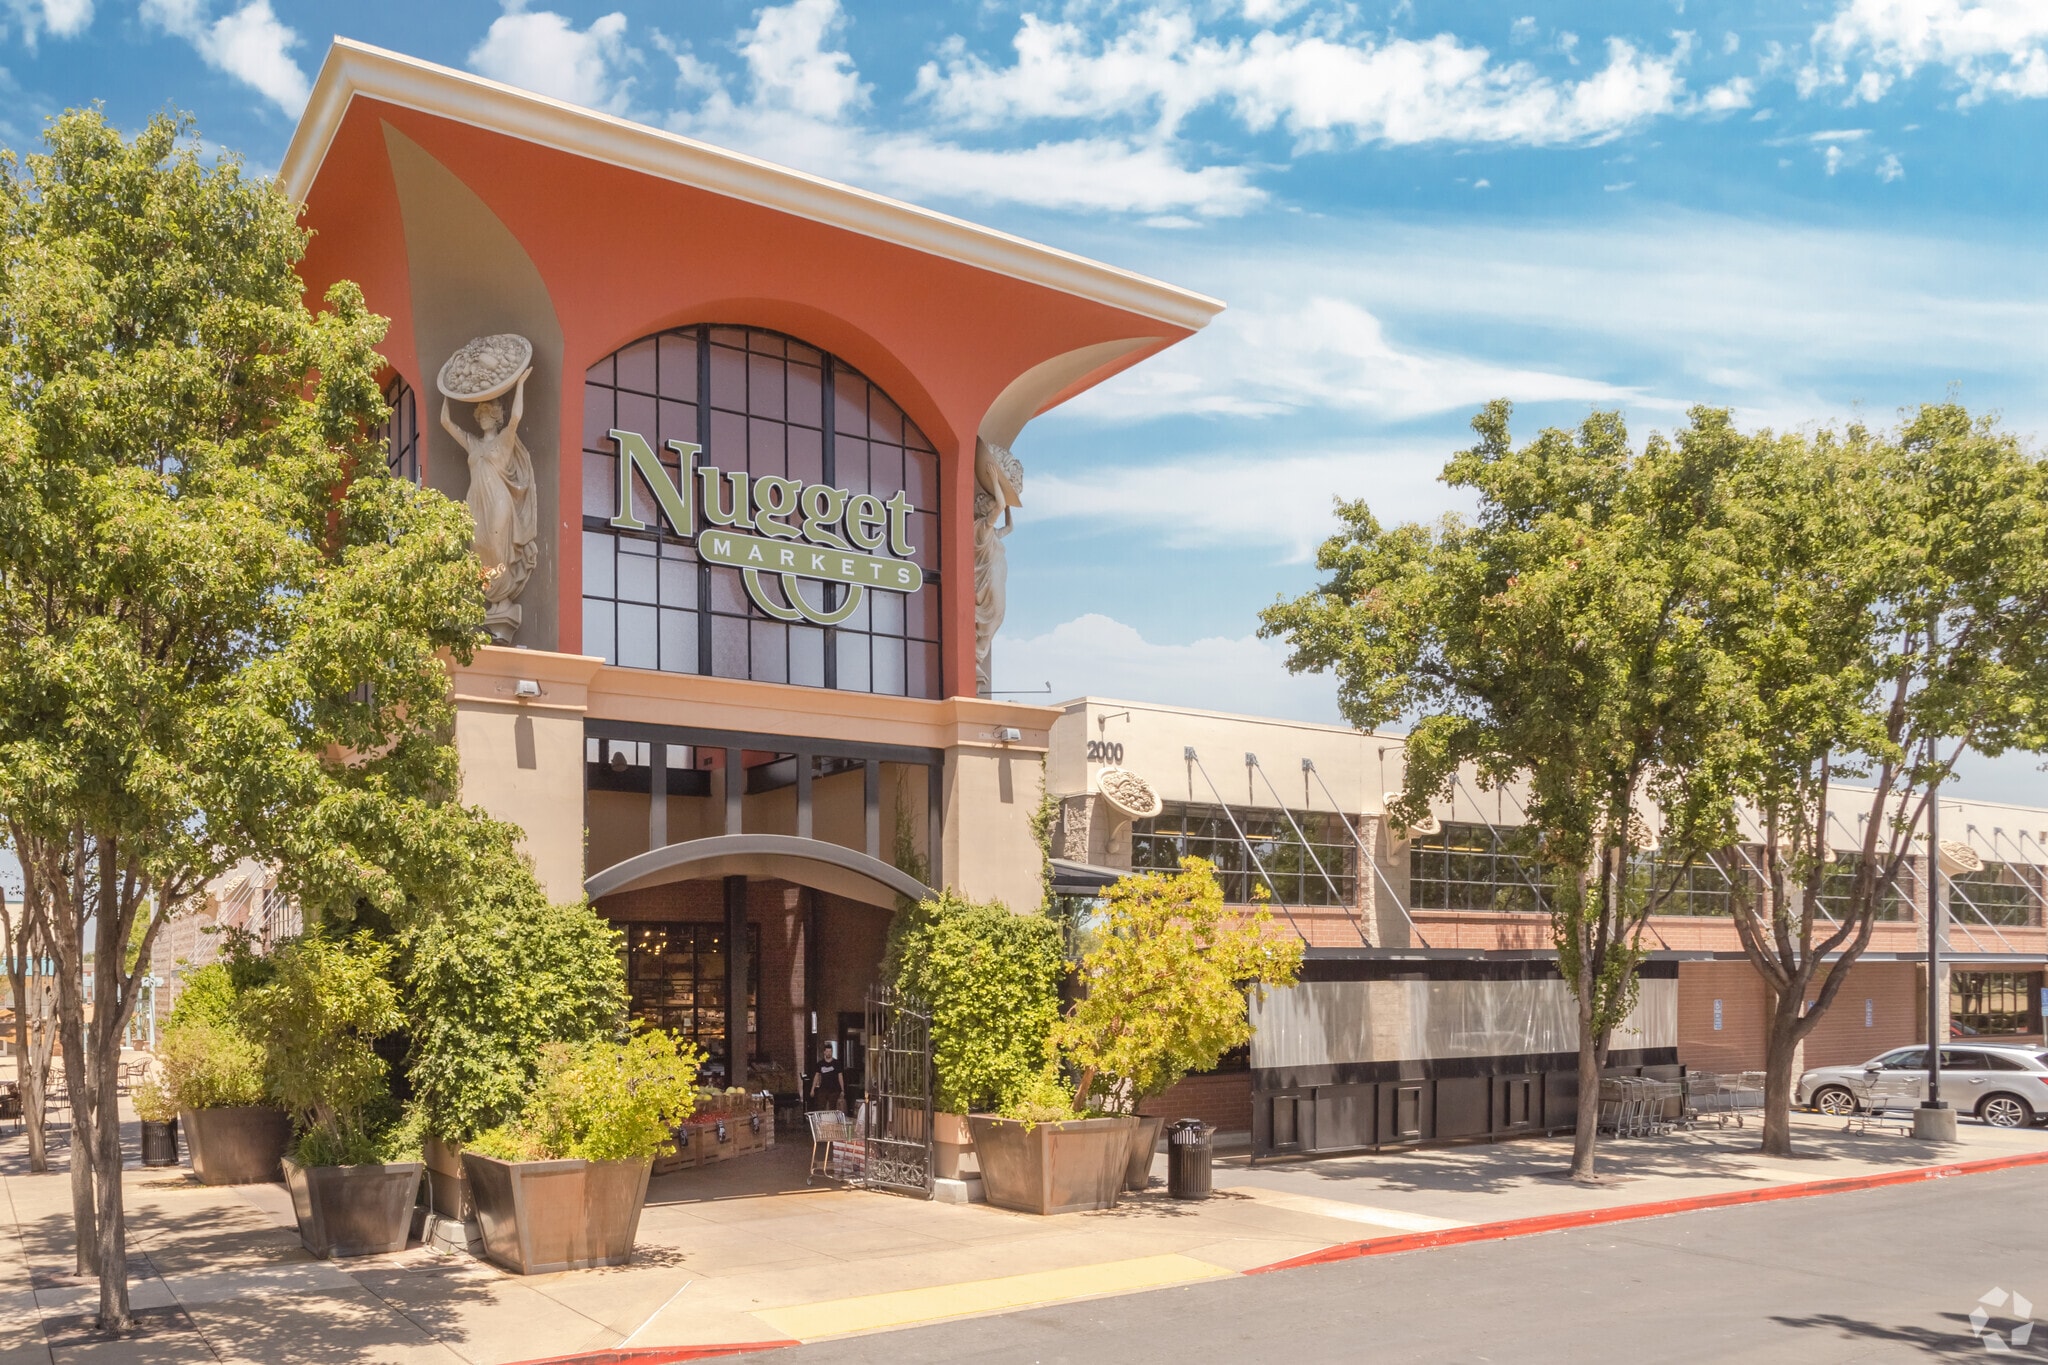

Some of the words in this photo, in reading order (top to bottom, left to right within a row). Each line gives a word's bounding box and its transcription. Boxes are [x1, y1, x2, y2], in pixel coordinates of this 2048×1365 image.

[607, 428, 917, 625] Nugget
[713, 537, 911, 584] MARKETS
[1087, 740, 1124, 762] 2000
